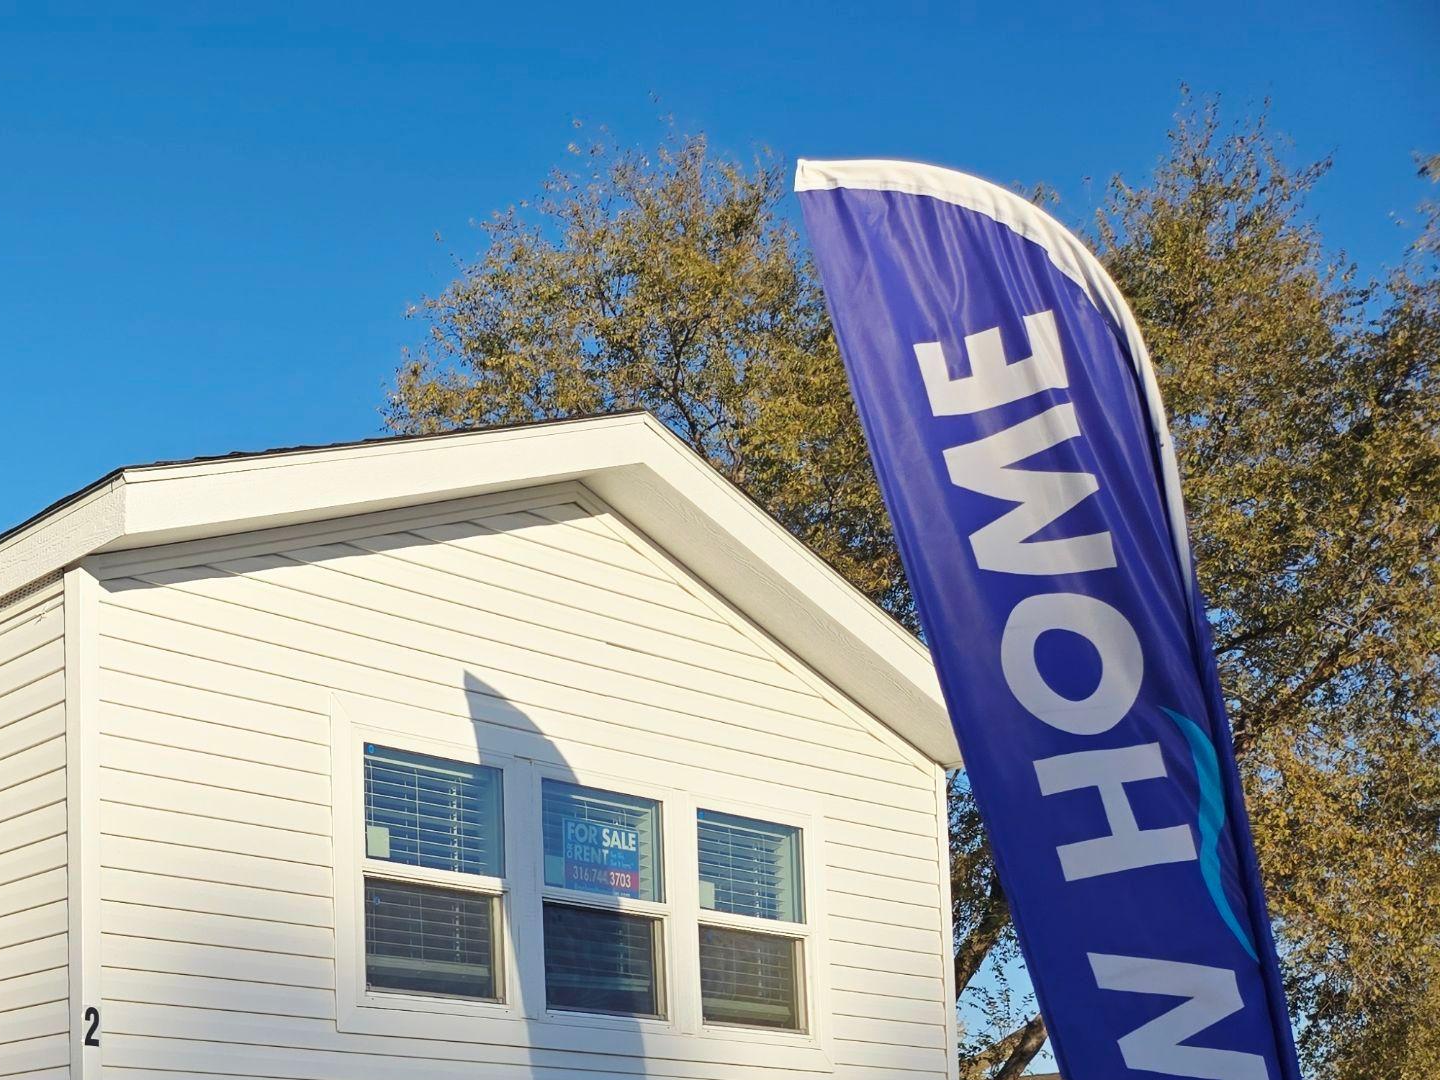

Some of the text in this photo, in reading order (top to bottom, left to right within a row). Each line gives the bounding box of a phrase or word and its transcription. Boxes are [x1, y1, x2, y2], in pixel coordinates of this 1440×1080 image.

[914, 309, 1198, 882] HOME
[567, 821, 636, 852] FOR SALE
[574, 844, 609, 865] RENT
[85, 1006, 99, 1047] 2
